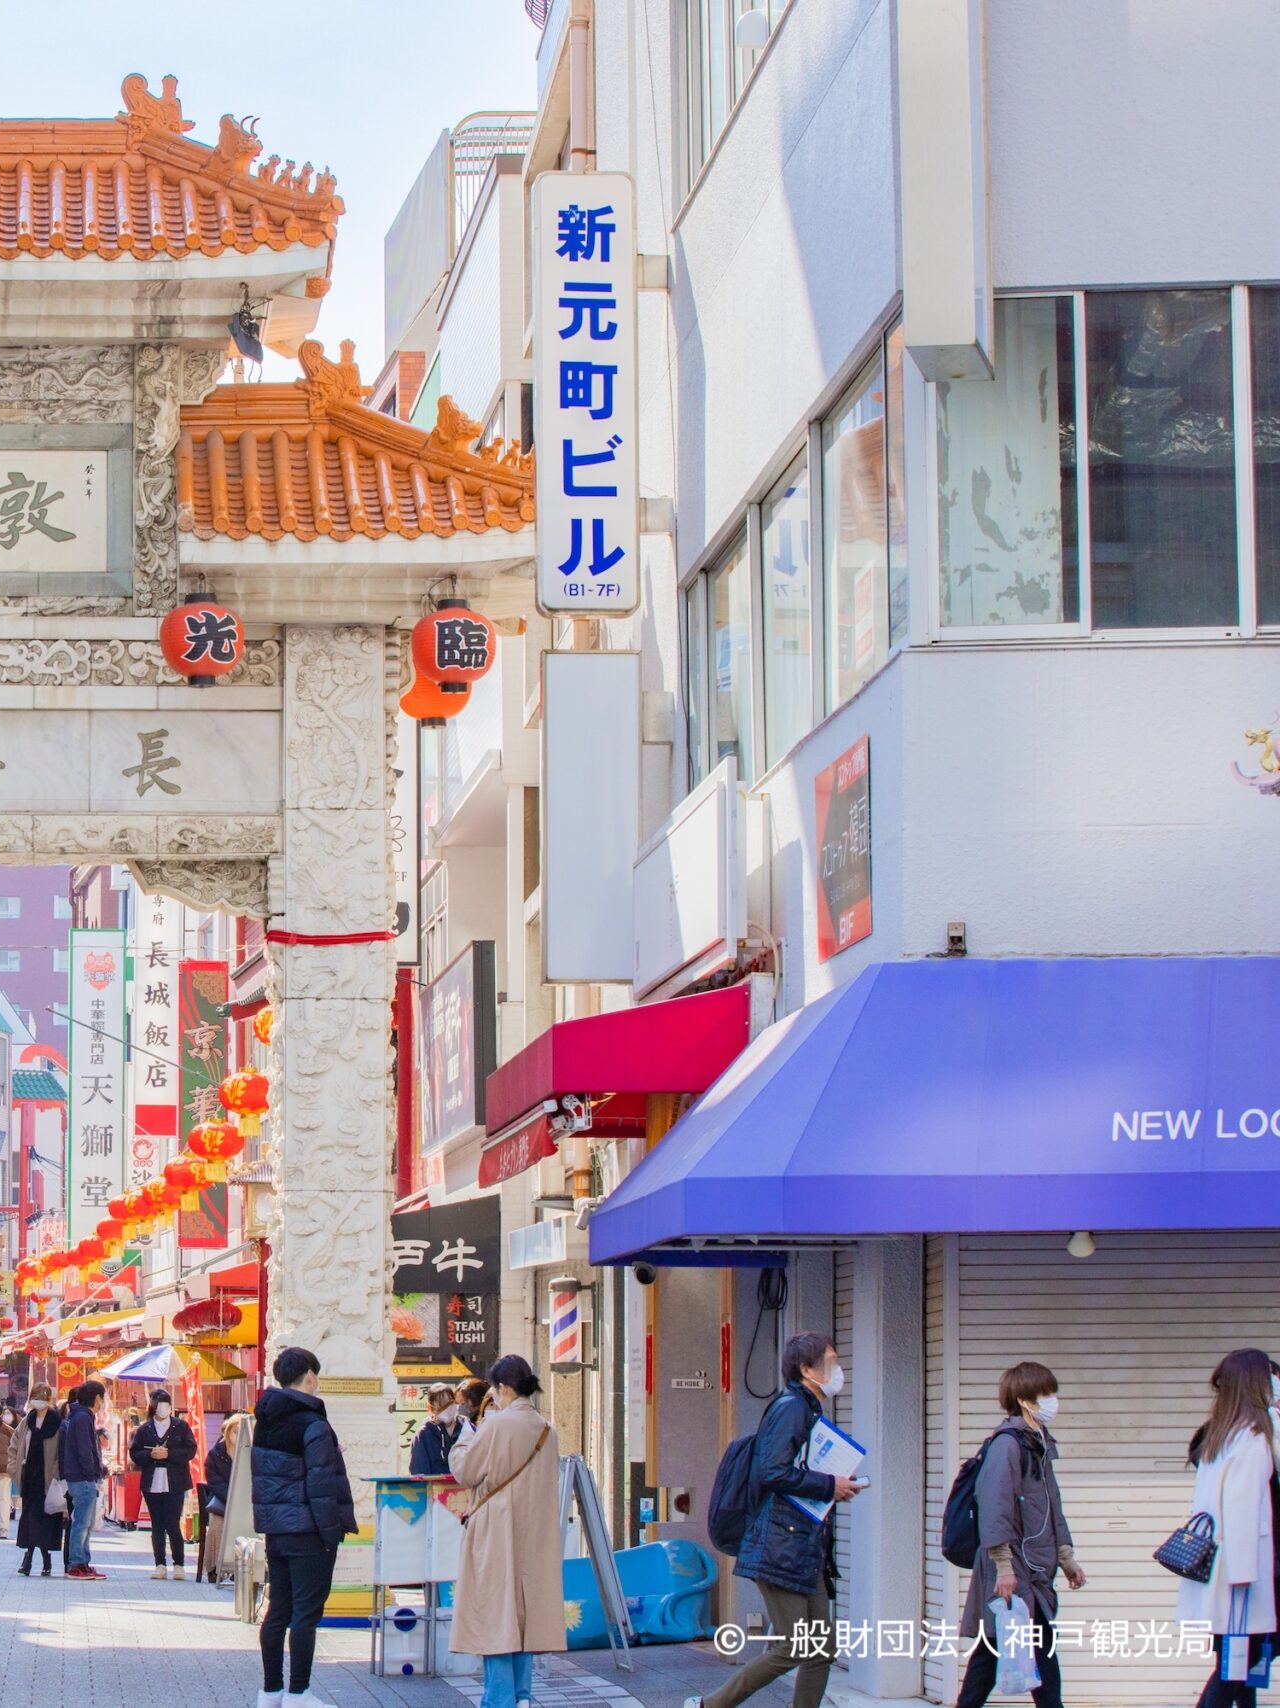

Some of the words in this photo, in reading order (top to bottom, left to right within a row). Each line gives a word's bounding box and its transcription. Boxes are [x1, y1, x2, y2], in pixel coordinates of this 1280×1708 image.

[555, 204, 626, 577] 新元町ビル
[180, 610, 238, 663] 光
[433, 617, 489, 670] 臨
[144, 941, 171, 1088] 長城飯店
[80, 1073, 114, 1208] 天獅堂
[1112, 1109, 1202, 1142] NEW
[446, 1295, 483, 1317] 寿司
[447, 1320, 485, 1331] STEAK
[447, 1332, 485, 1345] SUSHI
